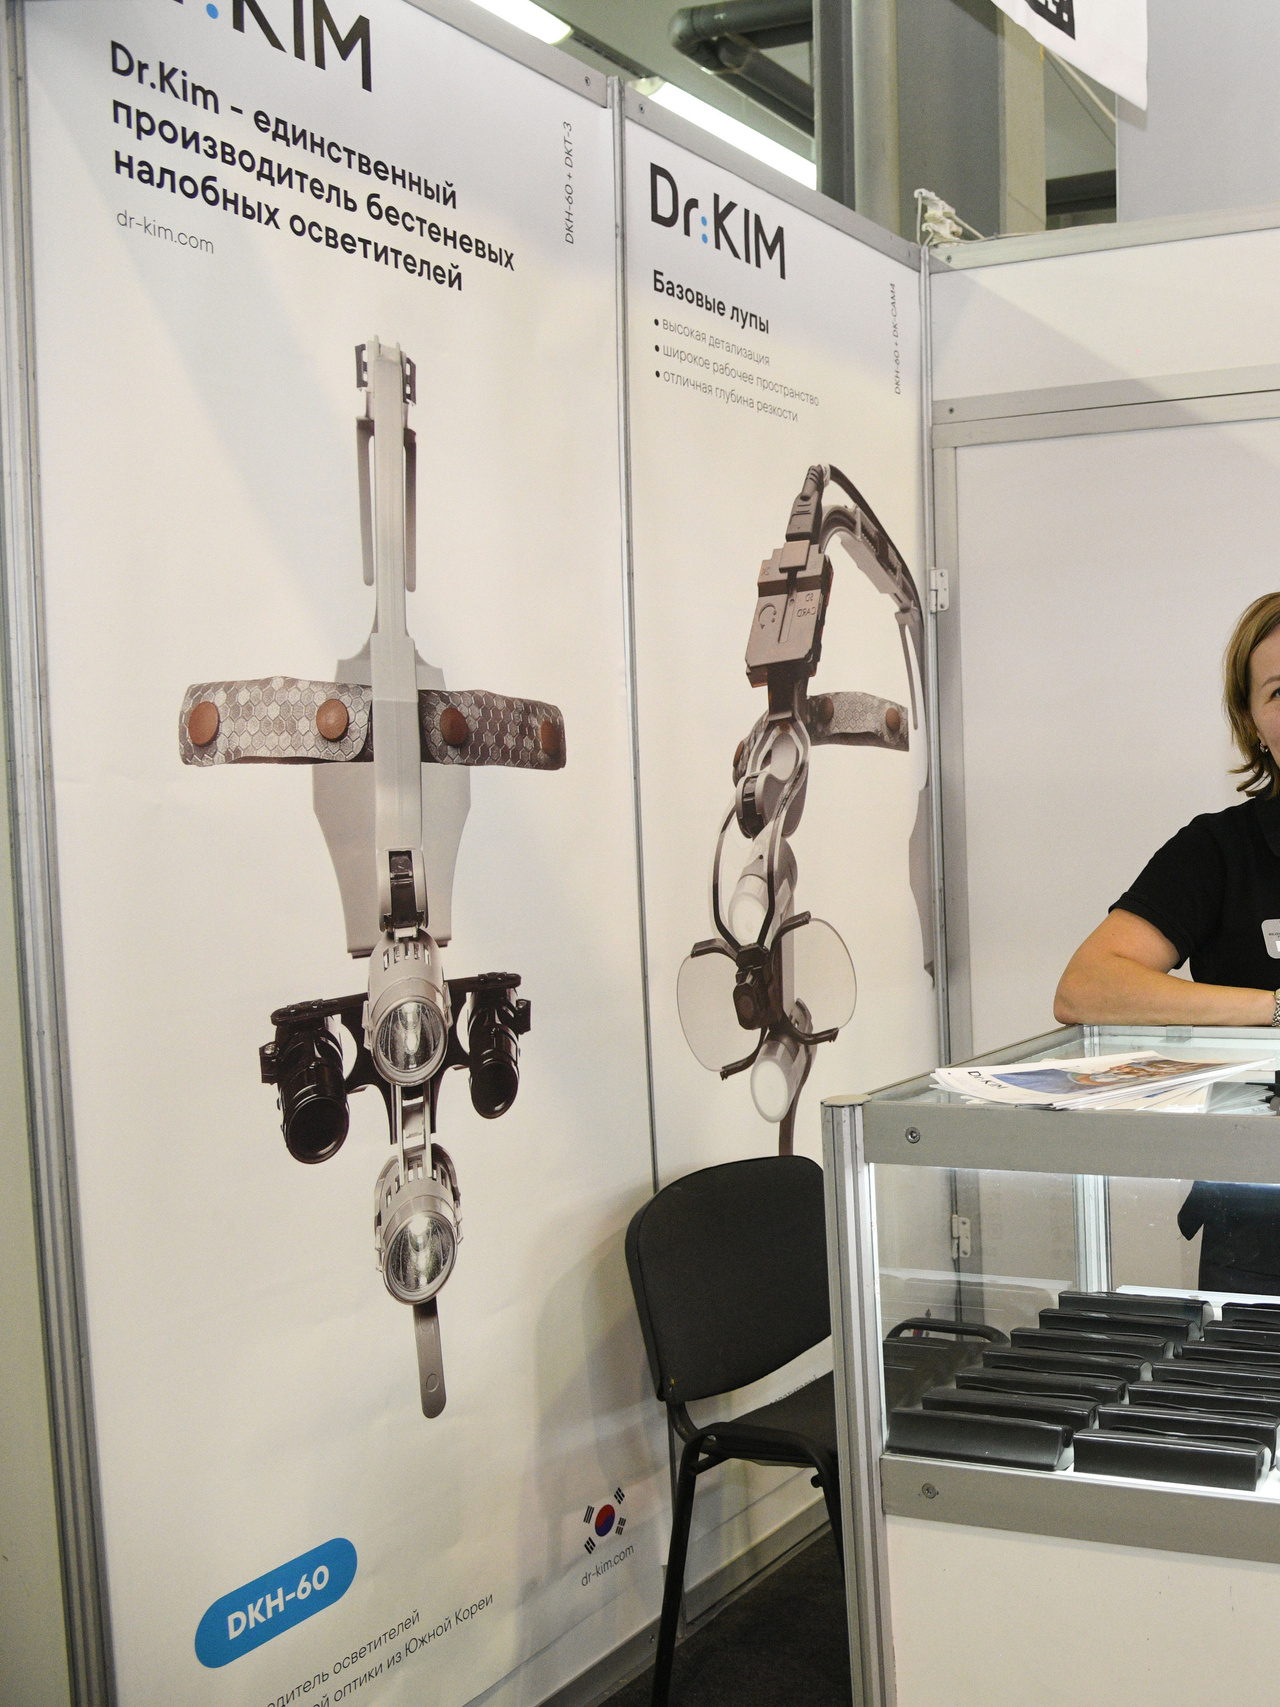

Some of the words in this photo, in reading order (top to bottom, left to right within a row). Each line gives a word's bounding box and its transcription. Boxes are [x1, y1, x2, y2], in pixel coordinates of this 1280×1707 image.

[111, 40, 219, 114] Dr.Kim
[253, 109, 458, 210] единственный
[562, 121, 574, 168] DKT-3
[112, 98, 358, 214] производитель
[366, 193, 515, 272] бестеневых
[563, 184, 575, 244] DKH-60
[113, 151, 281, 230] налобных
[289, 213, 463, 291] осветителей
[116, 210, 215, 255] dr-kim.com
[653, 269, 726, 317] Базовые
[730, 305, 769, 334] лупы
[662, 318, 707, 343] высокая
[708, 335, 770, 366] детализация
[662, 344, 711, 370] широкое
[712, 361, 754, 385] рабочее
[756, 376, 820, 407] пространство
[663, 371, 713, 395] отличная
[715, 386, 755, 409] глубина
[756, 400, 799, 422] резкости
[581, 1543, 635, 1587] dr-kim.com
[226, 1565, 330, 1640] DKH-60
[332, 1609, 420, 1675] осветителей
[333, 1662, 383, 1702] оптики
[386, 1651, 402, 1669] из
[404, 1617, 452, 1658] Южной
[454, 1593, 494, 1626] Кореи
